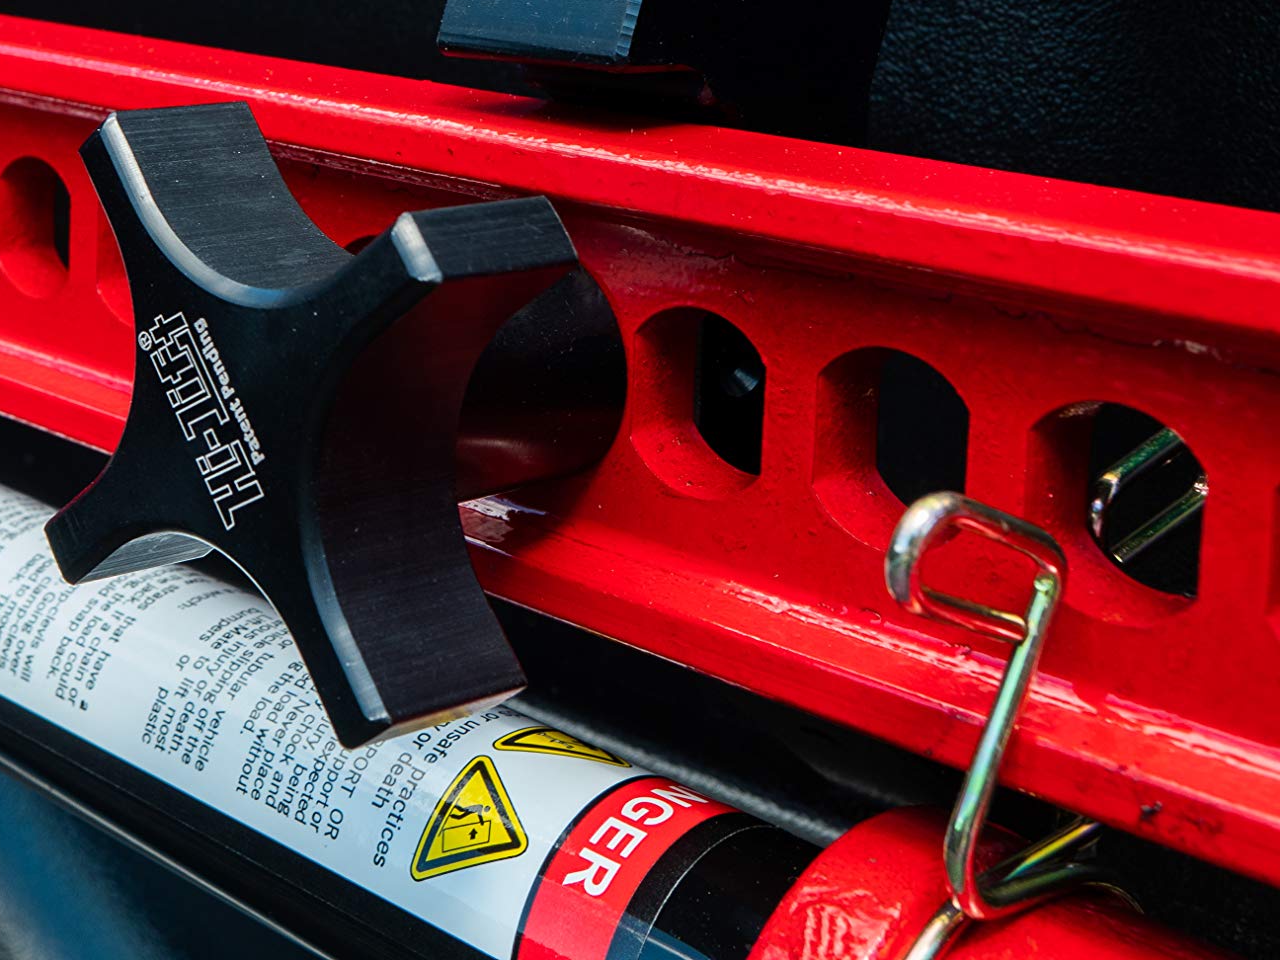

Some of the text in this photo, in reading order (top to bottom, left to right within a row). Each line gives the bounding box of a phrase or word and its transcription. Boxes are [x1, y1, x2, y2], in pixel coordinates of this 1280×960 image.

[193, 317, 266, 466] Patent Pending
[9, 591, 56, 677] Going over
[68, 597, 99, 633] snap
[74, 615, 104, 649] load
[108, 615, 137, 644] that
[19, 654, 35, 683] will
[46, 635, 74, 679] back.
[54, 651, 78, 701] could
[73, 636, 102, 682] chain
[85, 650, 112, 691] have
[175, 654, 191, 672] or
[192, 655, 211, 670] to
[202, 649, 255, 705] slipping
[205, 640, 247, 678] injury
[226, 652, 276, 701] tubular
[67, 687, 79, 707] or
[79, 699, 88, 711] a
[173, 677, 195, 699] lift
[193, 679, 208, 699] or
[239, 673, 295, 735] the load.
[141, 686, 170, 745] plastic
[153, 706, 177, 752] most
[167, 700, 196, 755] death.
[192, 707, 209, 734] off
[271, 698, 312, 748] Never
[302, 716, 335, 751] jury,
[480, 712, 501, 723] or
[181, 735, 200, 765] the
[194, 710, 227, 772] vehicle
[235, 690, 298, 796] load without
[278, 713, 316, 766] chock
[412, 732, 432, 751] or
[423, 720, 481, 764] unsafe
[250, 748, 276, 801] place
[264, 770, 284, 810] and
[275, 763, 309, 818] being
[293, 739, 342, 826] expected
[309, 747, 349, 834] upport or
[323, 747, 378, 841] PORT OR
[370, 752, 413, 809] death
[372, 766, 426, 868] practices
[561, 786, 709, 896] NGER
